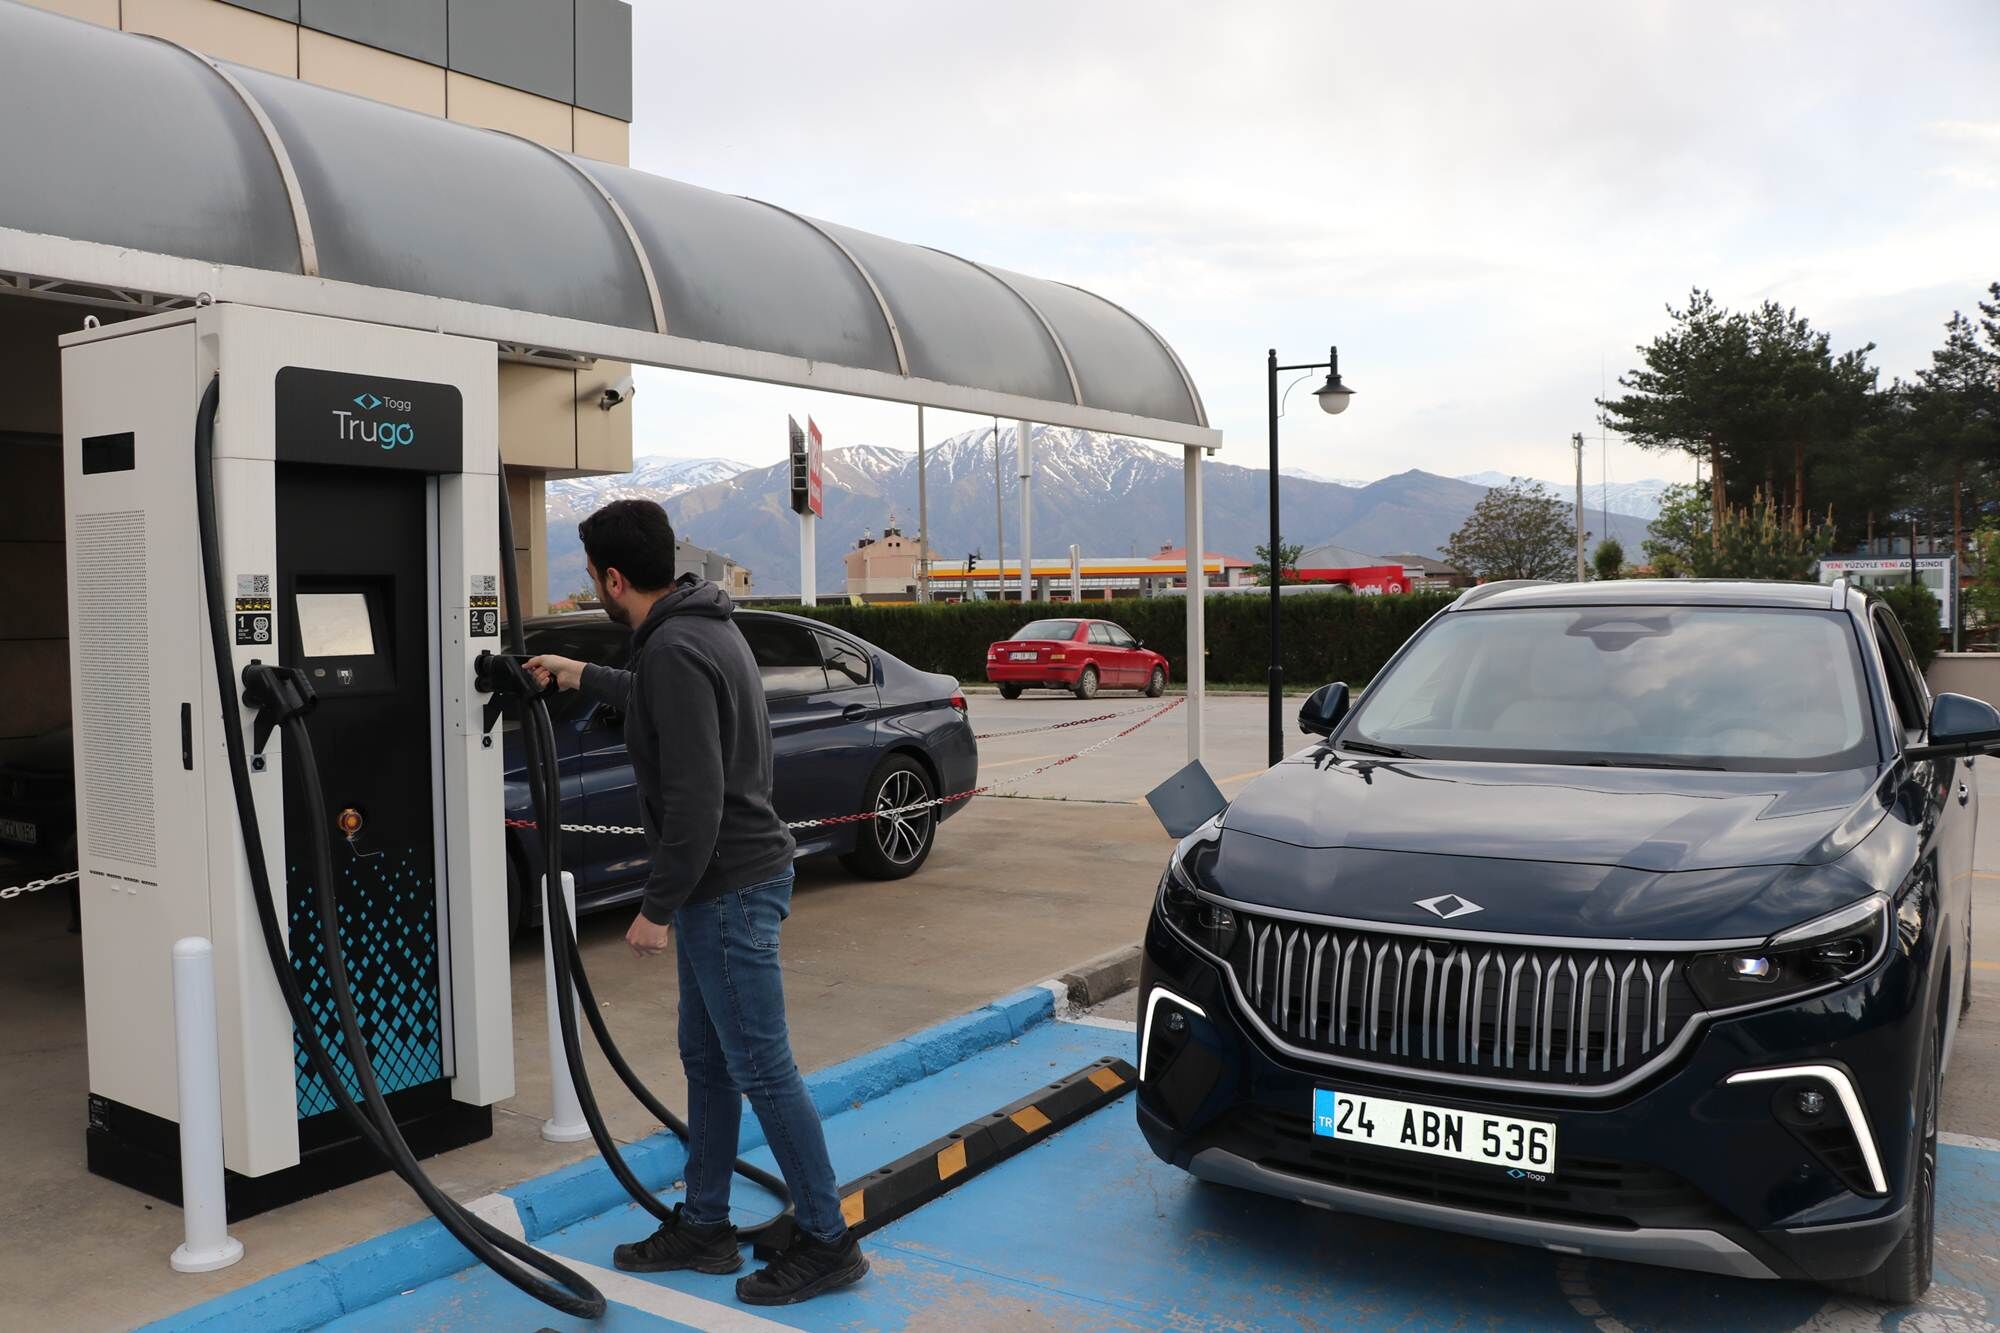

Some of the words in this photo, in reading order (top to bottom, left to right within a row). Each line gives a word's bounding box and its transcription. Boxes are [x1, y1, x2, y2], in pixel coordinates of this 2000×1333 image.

[383, 397, 411, 412] Togg
[332, 410, 414, 449] Trugo
[1900, 560, 1944, 568] ADESİNDE
[238, 616, 244, 628] 1
[472, 611, 478, 621] 2
[1319, 1116, 1332, 1128] TR
[1337, 1099, 1374, 1137] 24
[1400, 1108, 1463, 1152] ABN
[1483, 1120, 1548, 1165] 536
[1526, 1171, 1546, 1182] Togg
